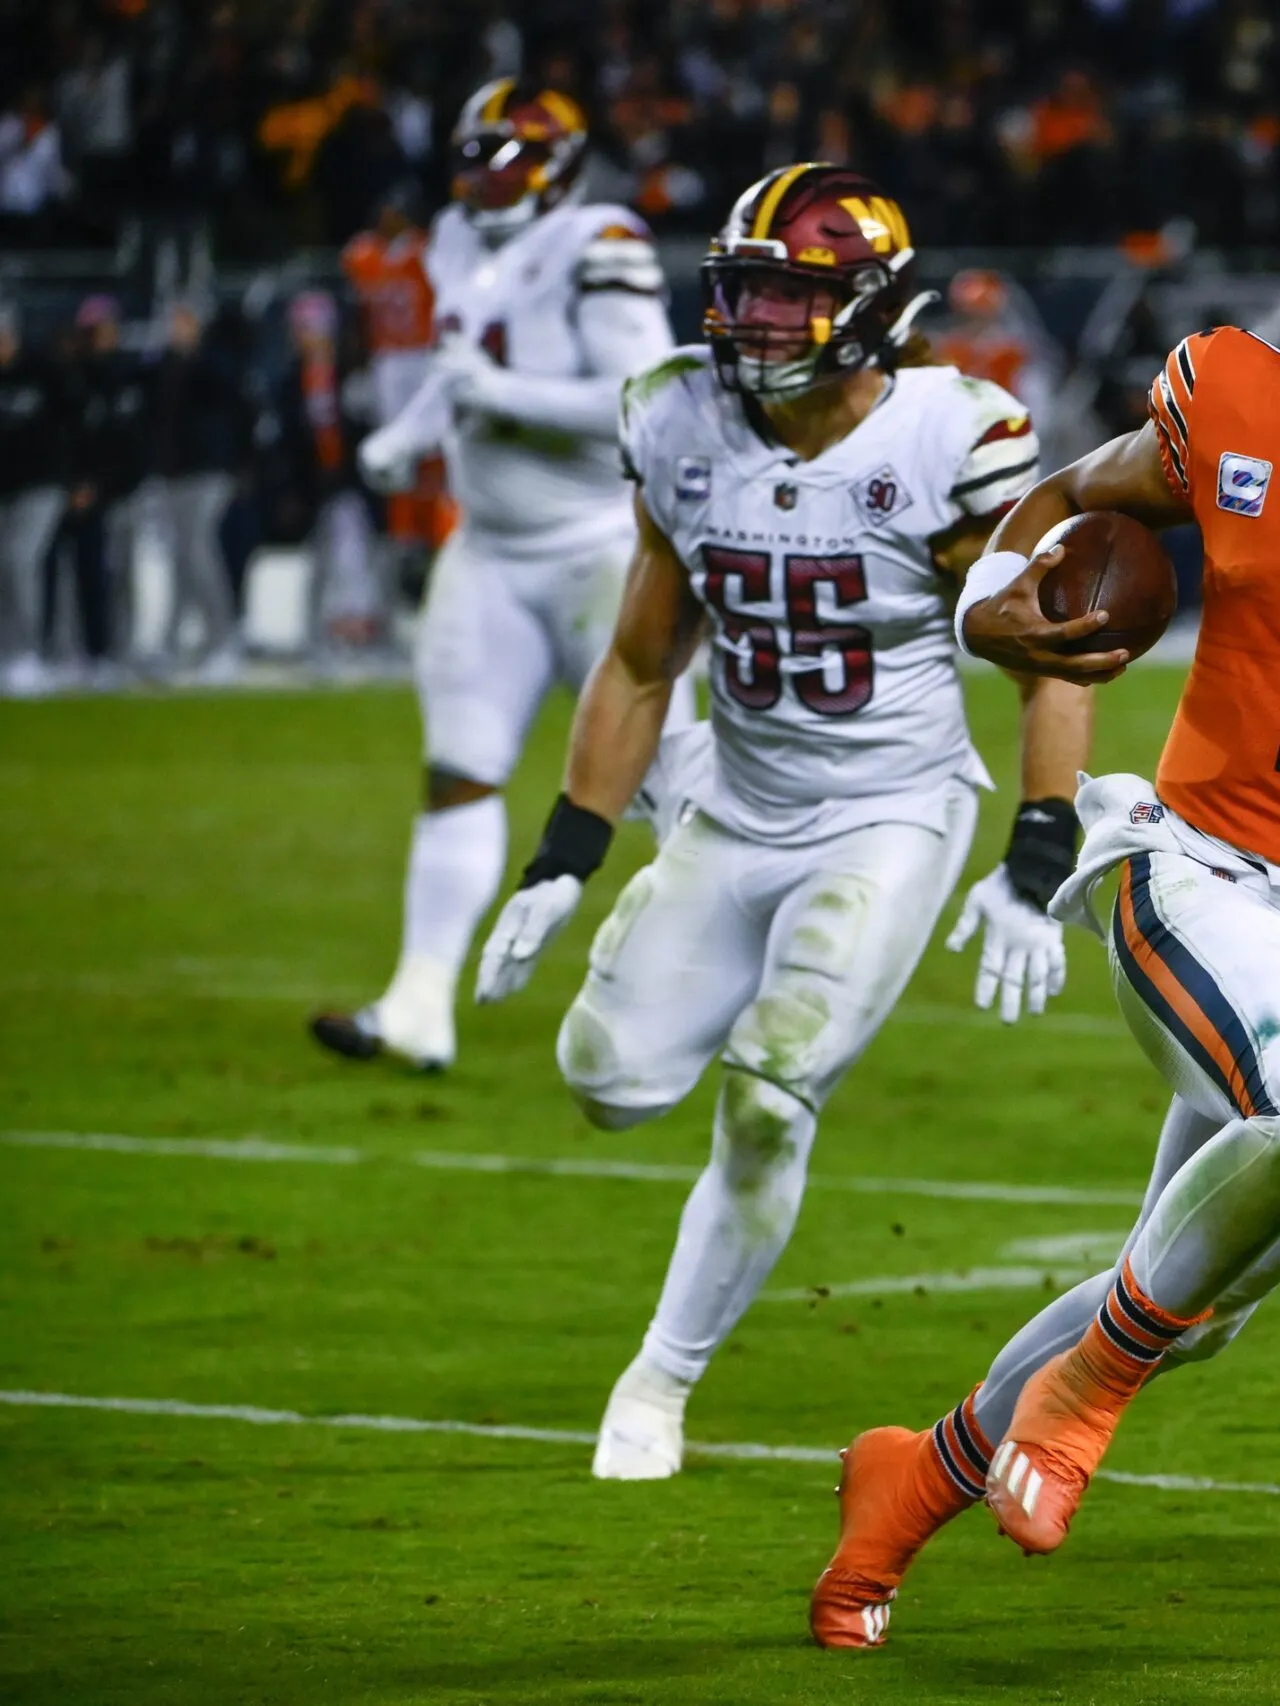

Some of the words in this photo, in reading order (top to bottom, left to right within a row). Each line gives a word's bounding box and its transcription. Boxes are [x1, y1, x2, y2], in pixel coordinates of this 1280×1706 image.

[866, 478, 898, 513] 90
[705, 525, 857, 549] WASHINGTON
[700, 543, 875, 716] 55
[1134, 804, 1153, 823] NFL
